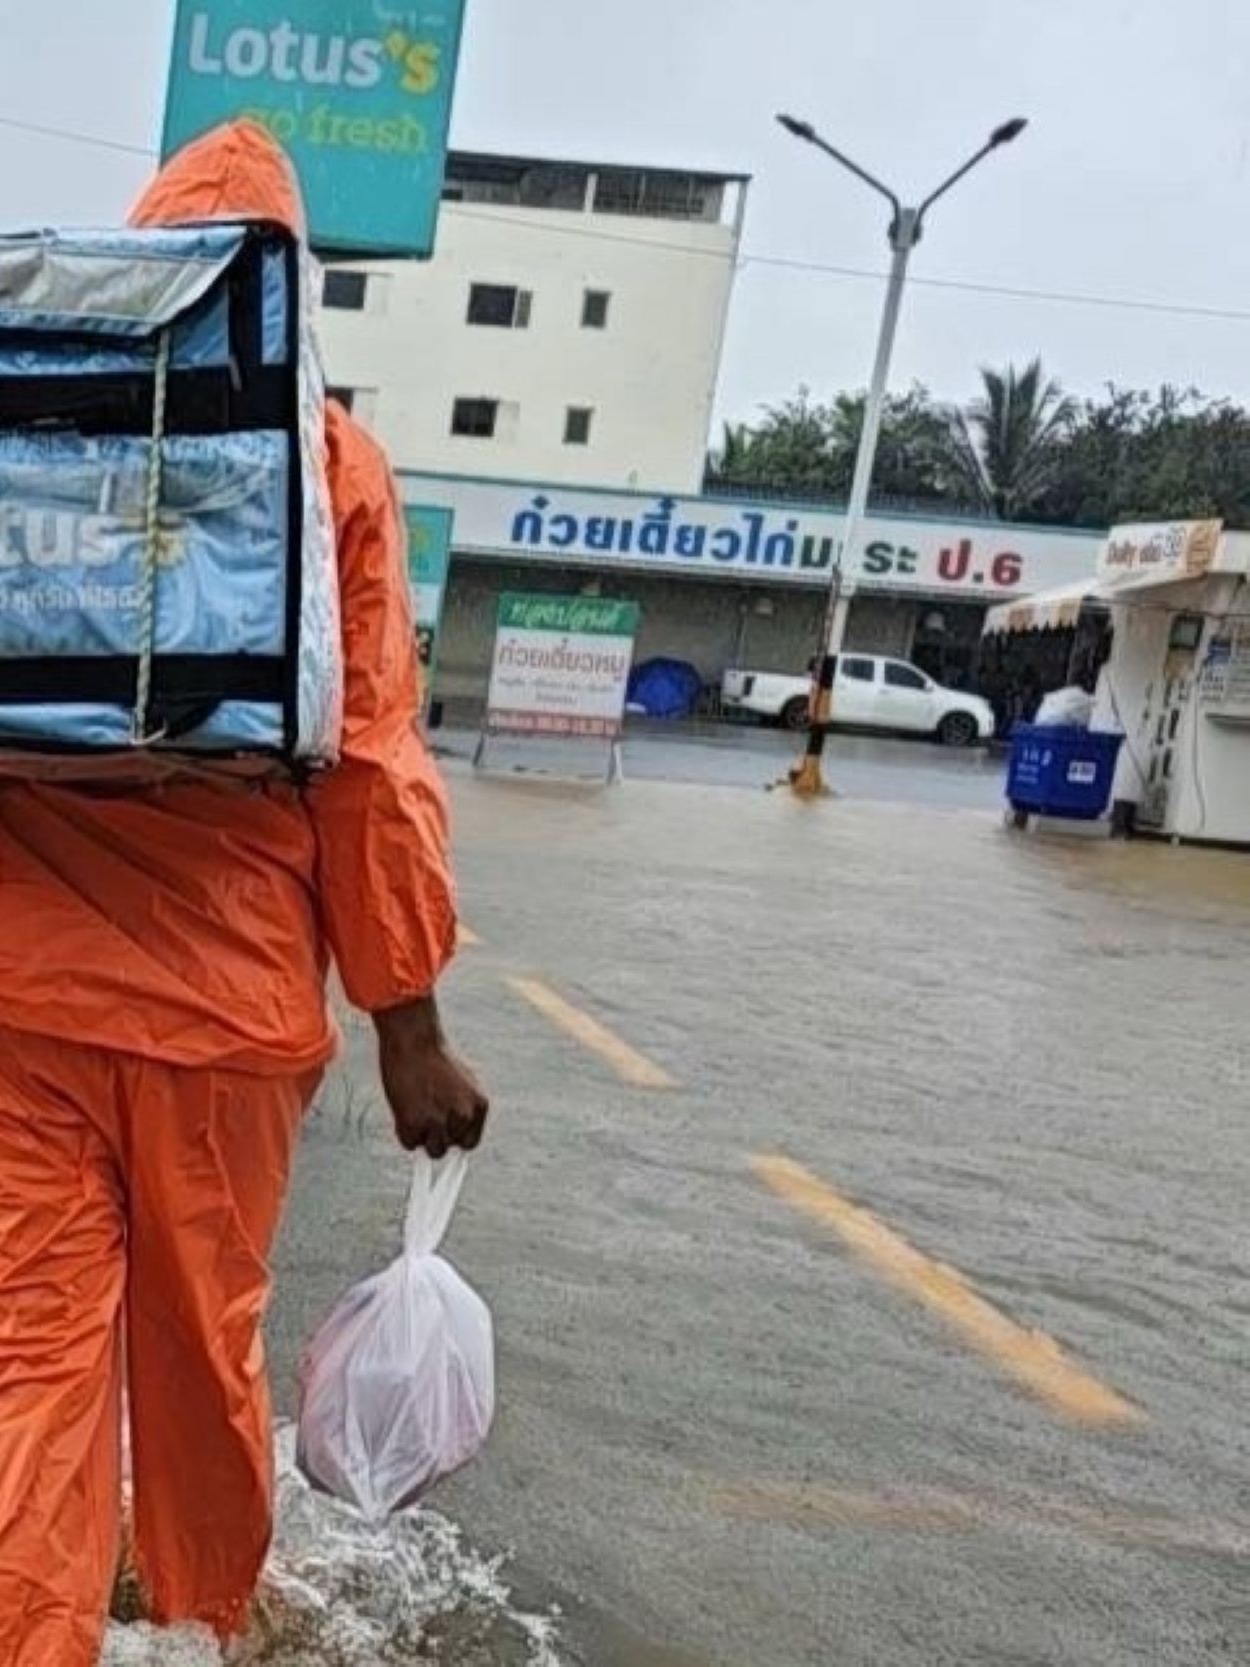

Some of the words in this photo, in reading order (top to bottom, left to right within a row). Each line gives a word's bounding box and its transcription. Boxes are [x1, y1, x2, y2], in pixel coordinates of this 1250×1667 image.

[187, 13, 441, 95] Lotus's
[308, 104, 430, 154] fresh
[937, 539, 1024, 586] ป.6
